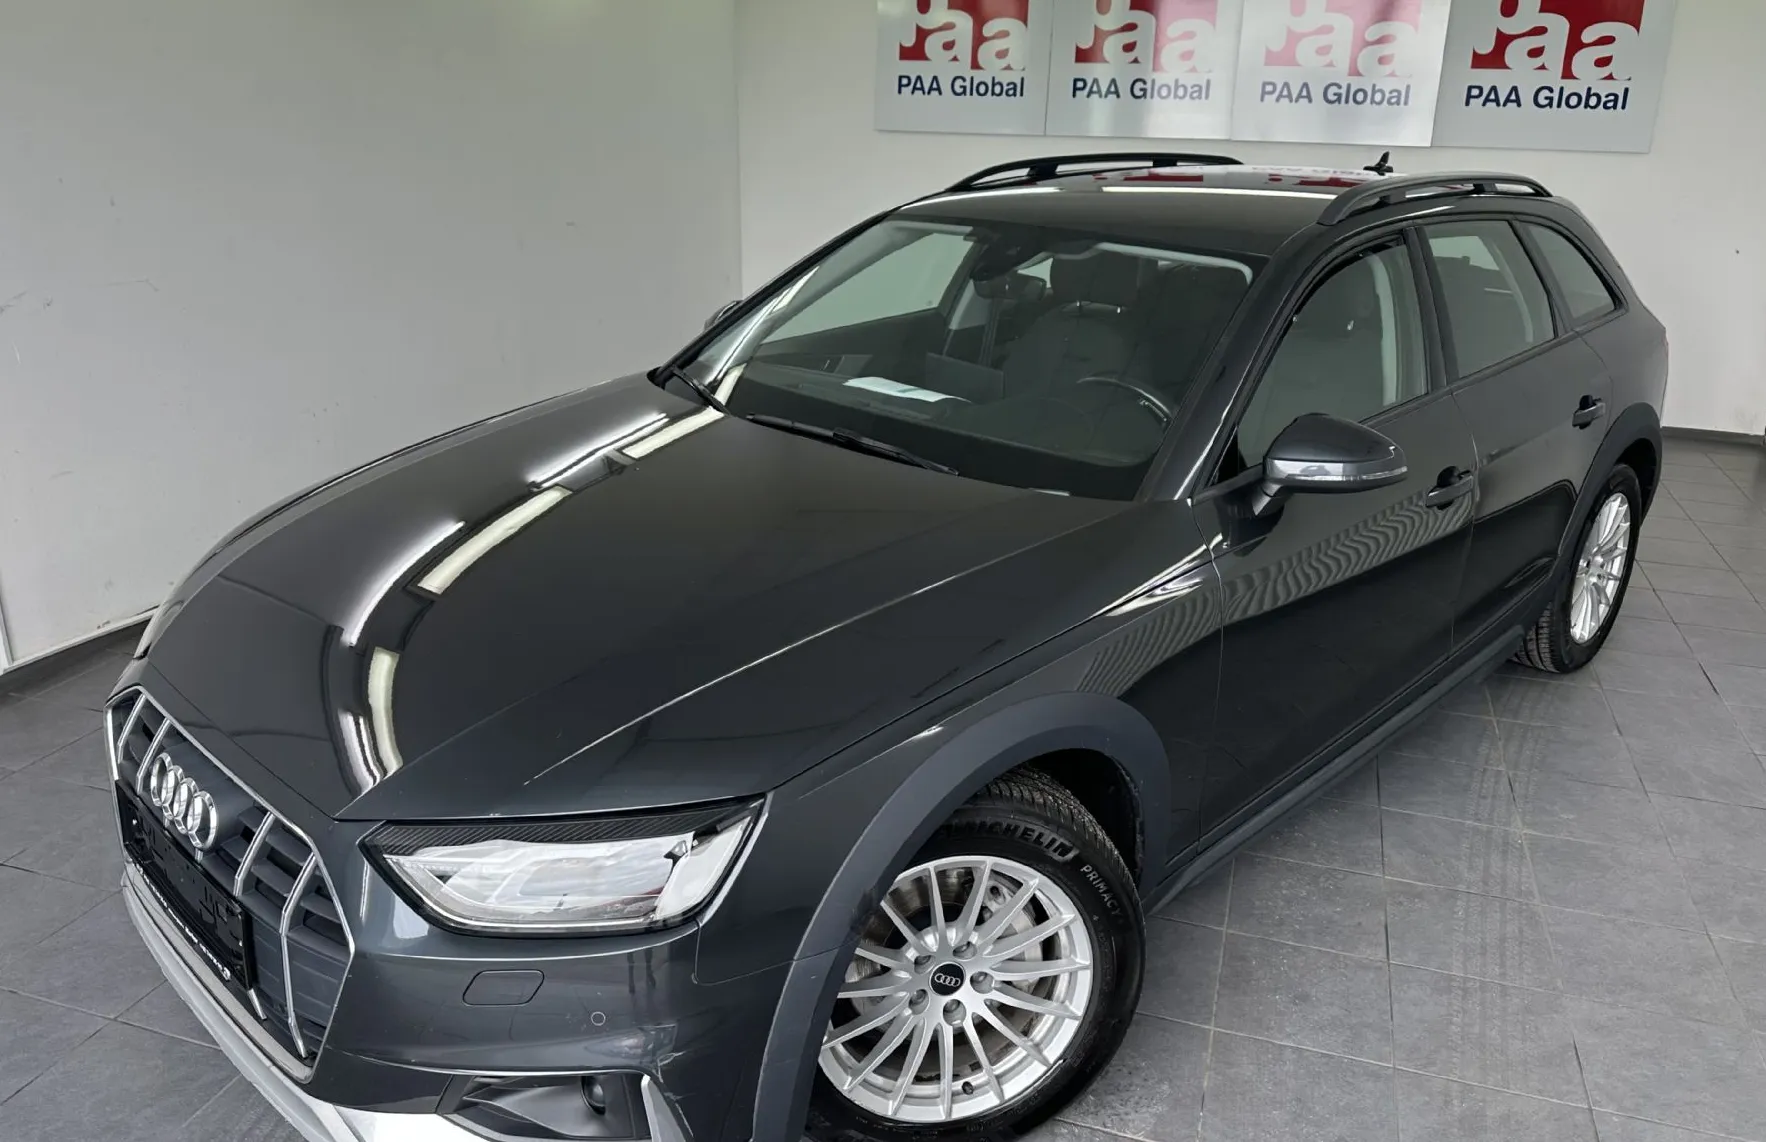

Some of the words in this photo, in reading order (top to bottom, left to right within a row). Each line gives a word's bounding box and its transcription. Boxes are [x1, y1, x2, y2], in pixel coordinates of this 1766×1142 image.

[898, 75, 942, 96] PAA
[951, 76, 1025, 98] Global
[1072, 78, 1121, 99] PAA
[1130, 78, 1211, 100] Global
[1260, 81, 1313, 104] PAA
[1323, 82, 1411, 107] Global
[1464, 84, 1522, 108] PAA
[1532, 85, 1629, 111] Global
[1080, 864, 1123, 917] PRIMACY
